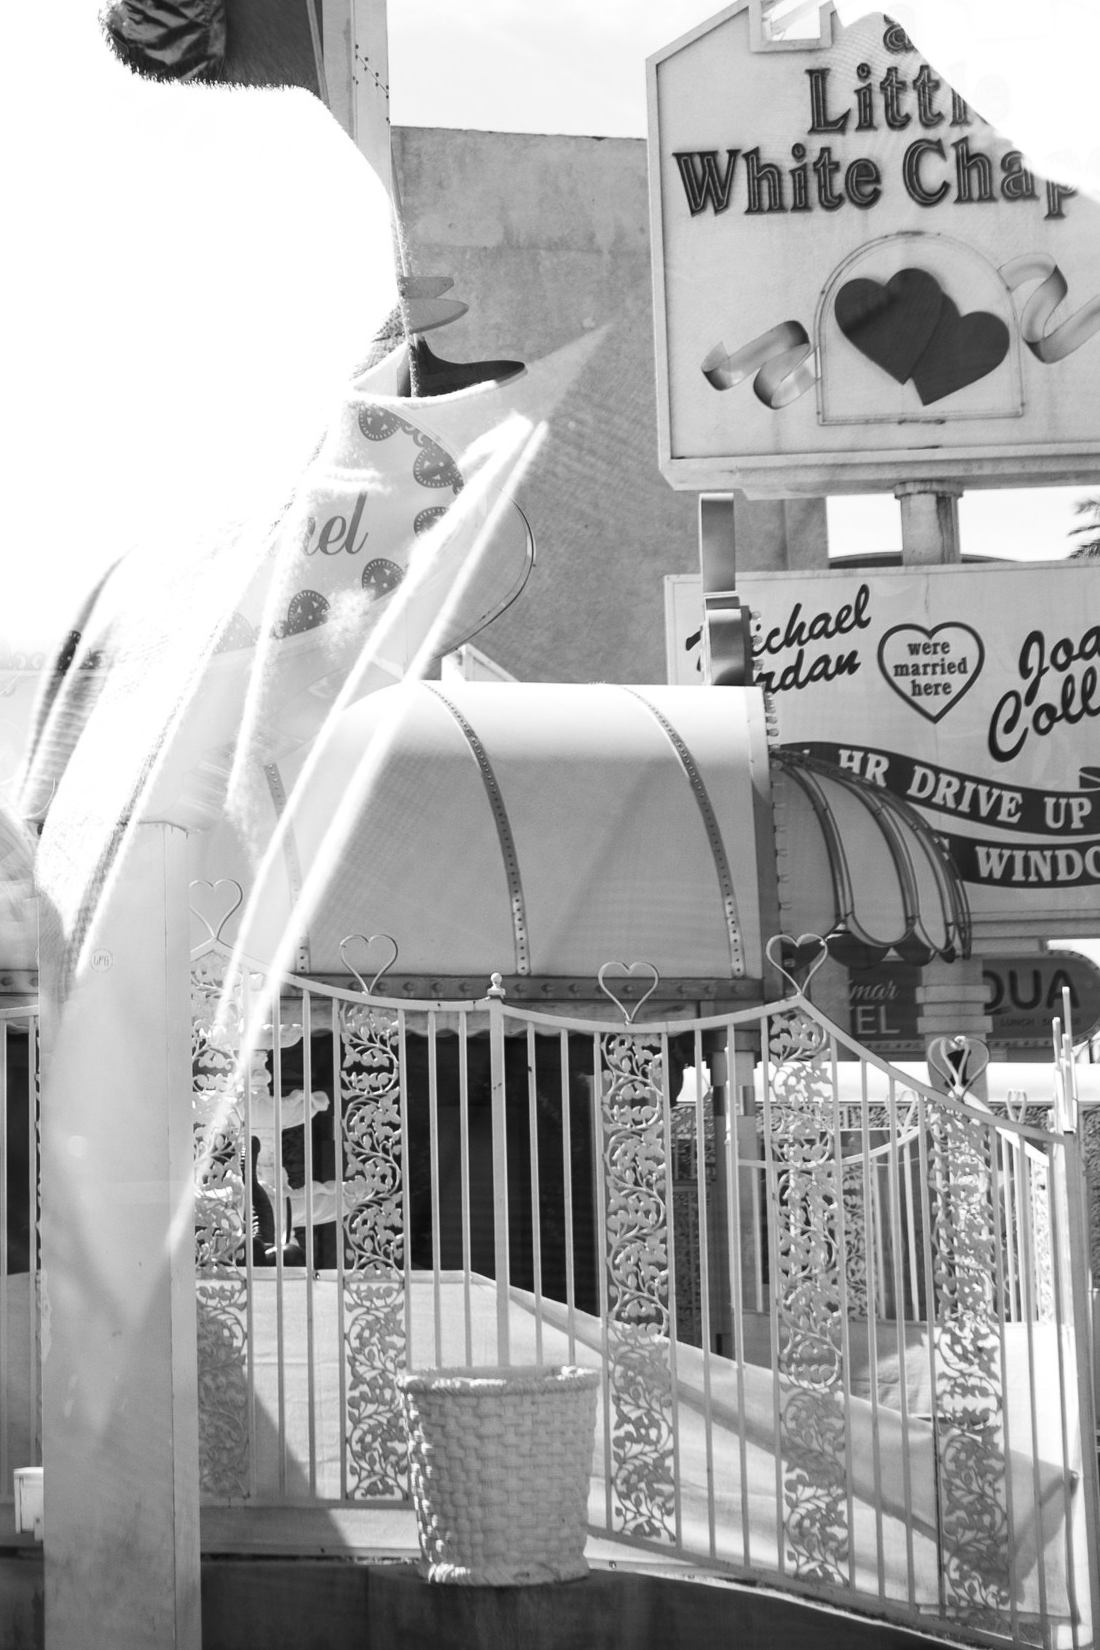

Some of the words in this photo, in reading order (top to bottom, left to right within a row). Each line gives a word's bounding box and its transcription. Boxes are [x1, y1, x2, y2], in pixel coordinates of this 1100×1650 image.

[805, 62, 992, 135] Littl
[672, 142, 882, 217] White
[685, 583, 871, 672] ichael
[907, 641, 951, 656] were
[893, 657, 968, 677] married
[910, 679, 952, 697] here
[838, 748, 890, 788] HR
[907, 764, 1023, 824] DRIVE
[1043, 796, 1092, 829] UP
[849, 1005, 900, 1035] EL
